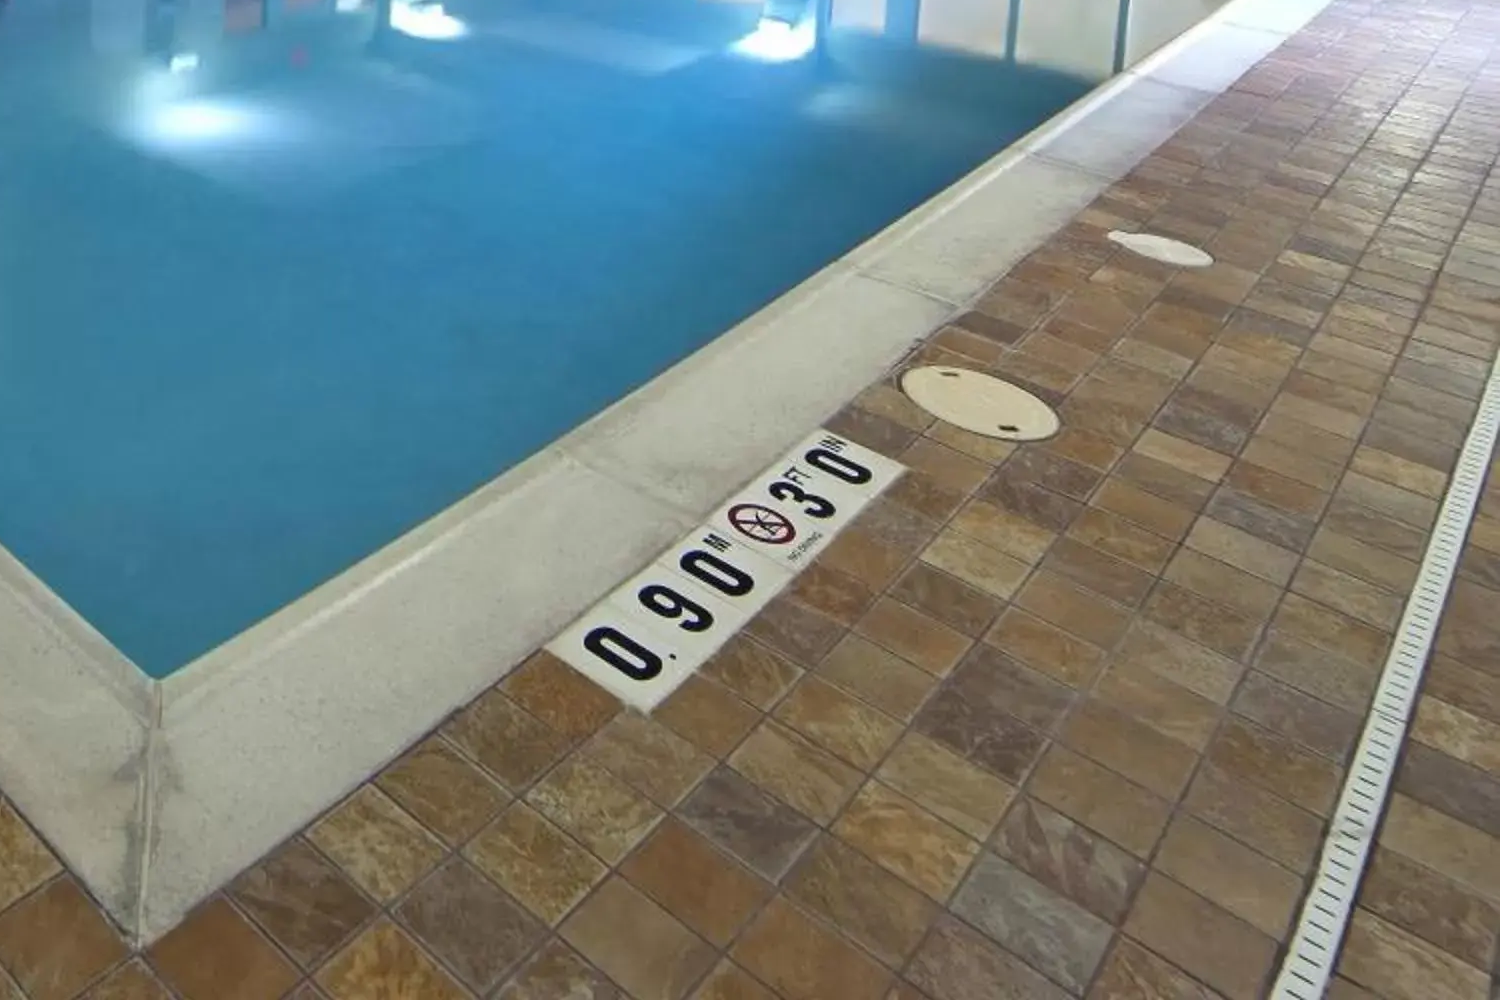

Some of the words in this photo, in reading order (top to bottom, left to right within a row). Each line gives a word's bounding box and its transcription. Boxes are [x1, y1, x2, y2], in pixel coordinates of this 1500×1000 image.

[781, 465, 813, 487] FT
[805, 448, 872, 485] 0
[769, 481, 837, 519] 3
